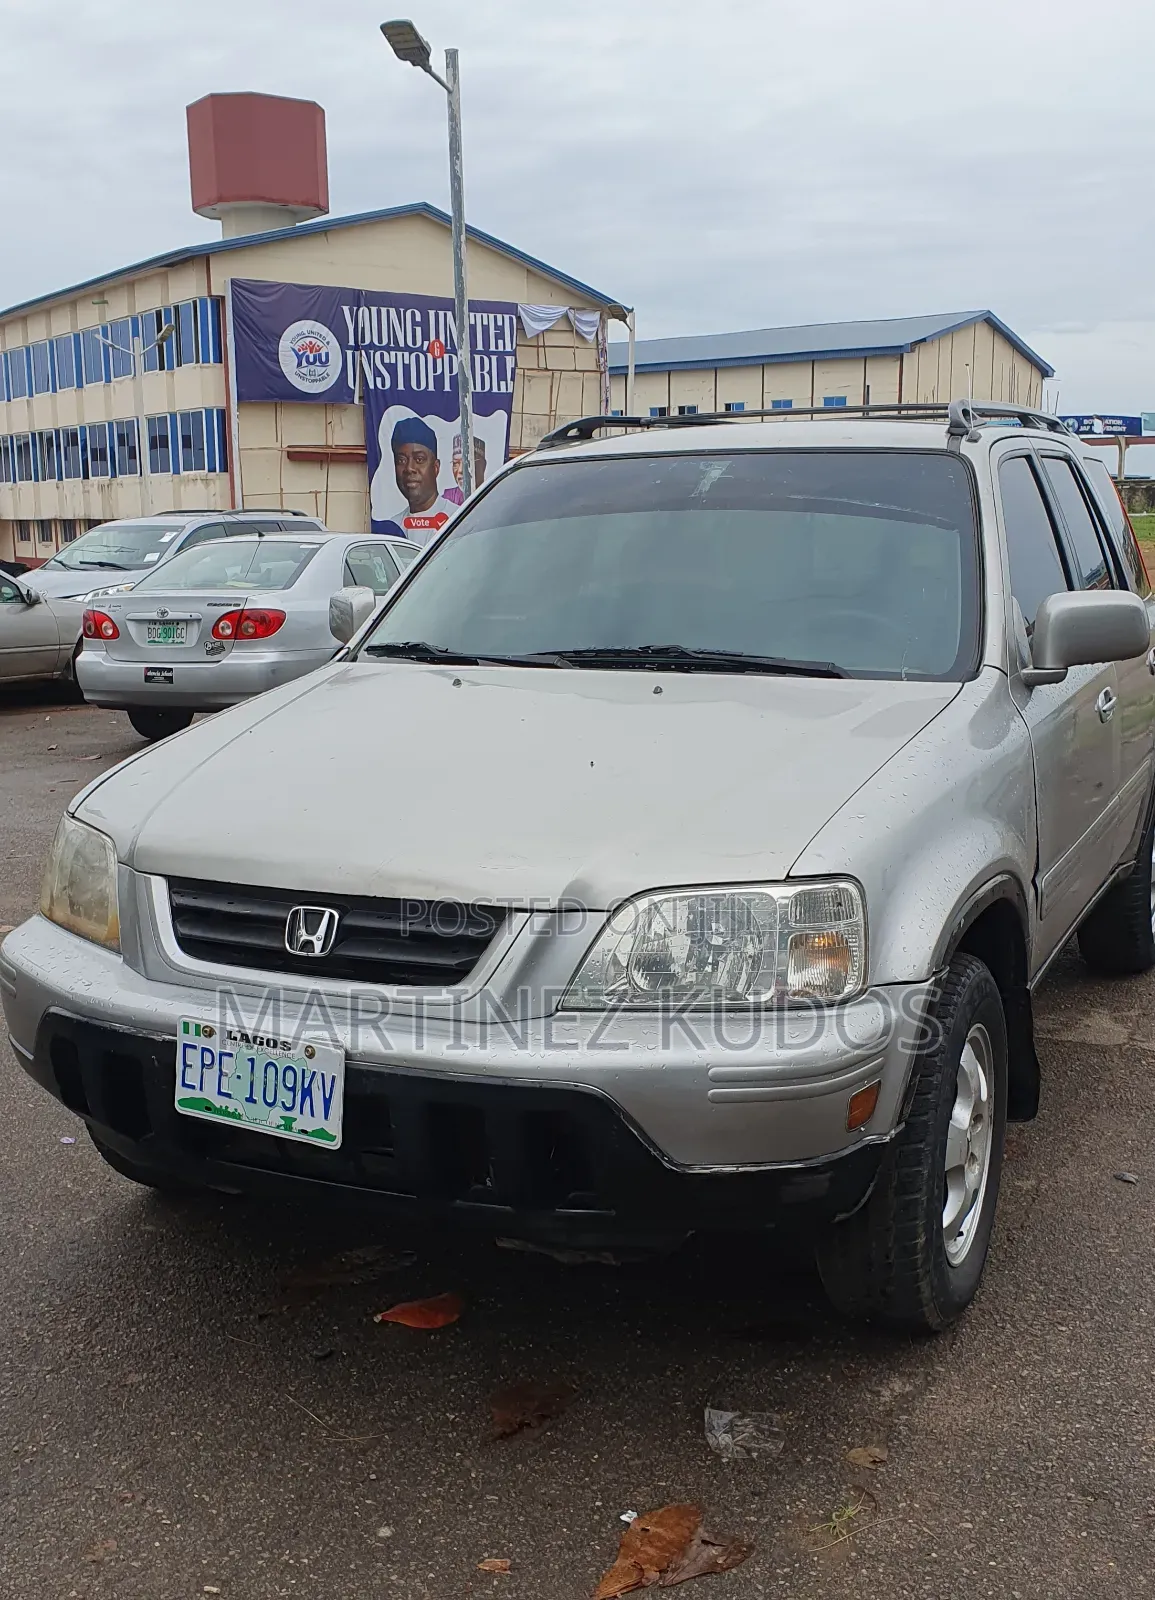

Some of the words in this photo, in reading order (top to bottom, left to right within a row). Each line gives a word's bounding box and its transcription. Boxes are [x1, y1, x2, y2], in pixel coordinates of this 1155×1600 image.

[306, 329, 327, 341] UNITED
[341, 305, 429, 351] YOUNG,
[427, 309, 517, 352] UNTED
[294, 371, 331, 384] UNSTOPPABLE
[410, 518, 430, 527] Vote
[226, 1029, 293, 1052] LAGOS
